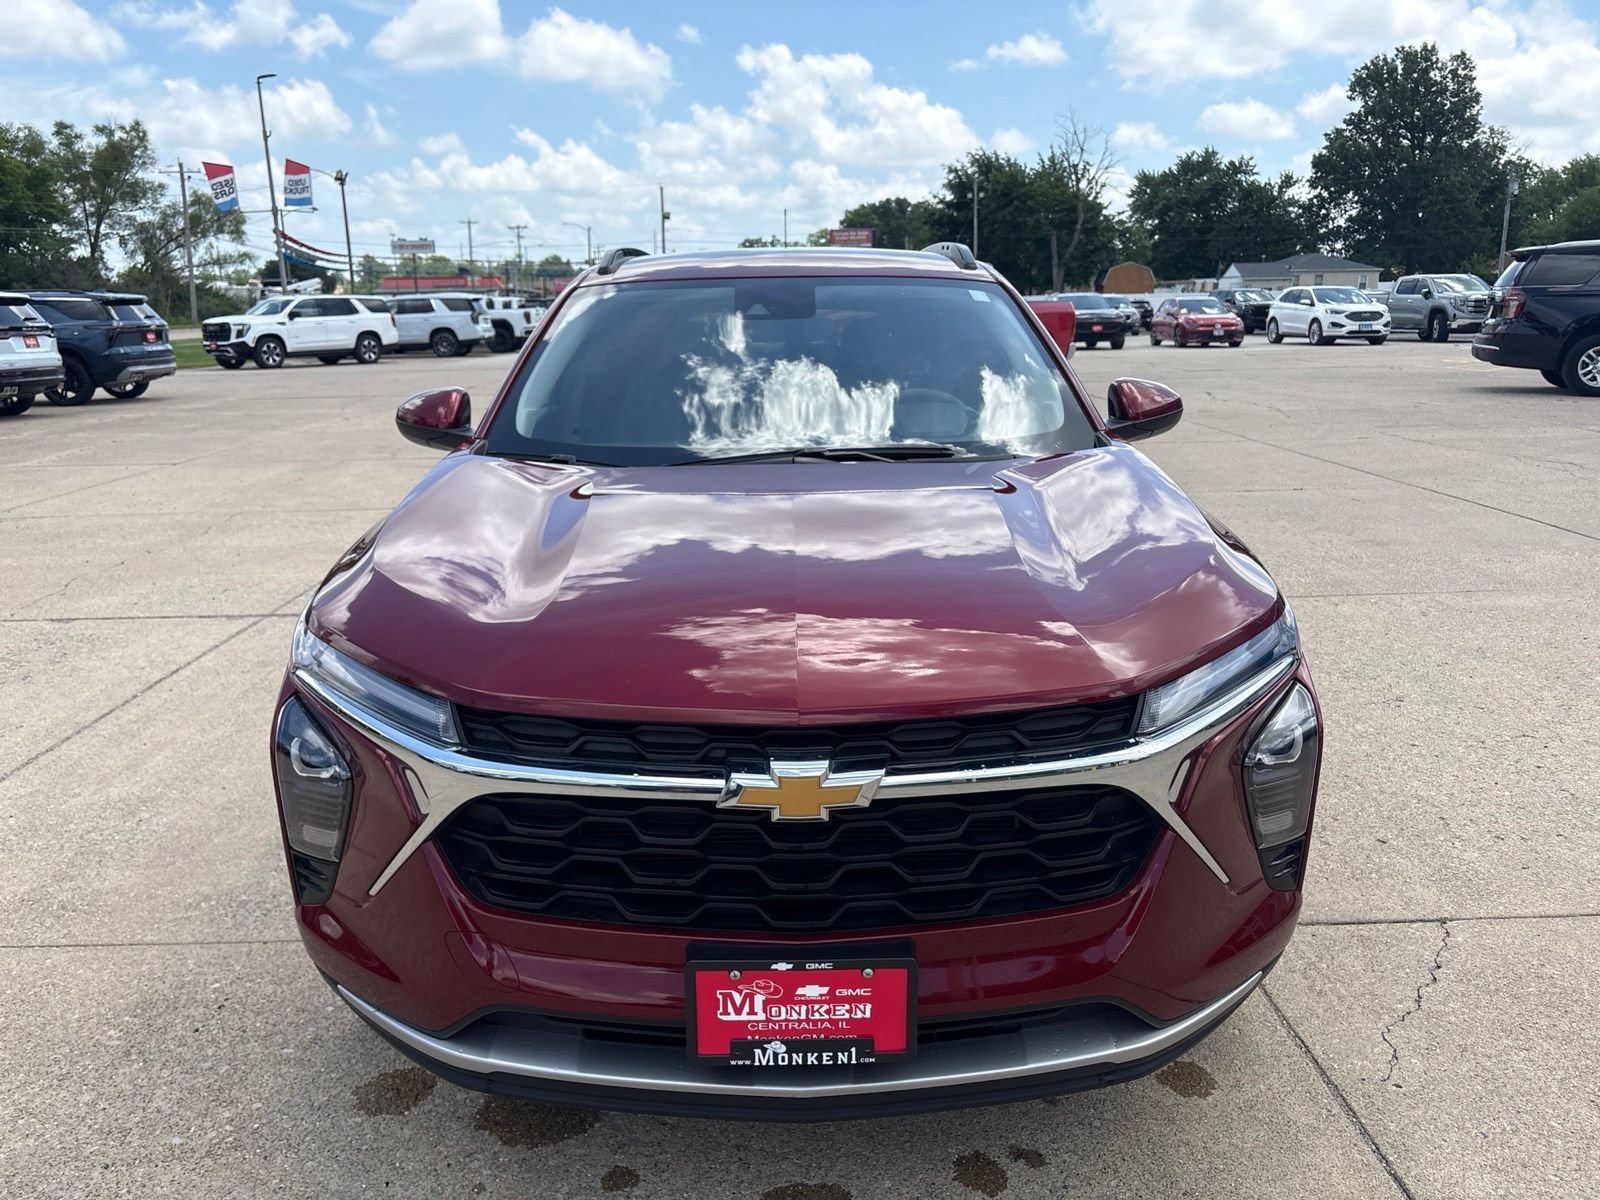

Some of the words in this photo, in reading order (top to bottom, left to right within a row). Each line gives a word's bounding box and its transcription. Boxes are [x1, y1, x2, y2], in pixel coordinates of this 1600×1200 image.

[805, 962, 833, 970] GMC
[835, 988, 872, 996] GMC
[716, 989, 873, 1021] MONKEN
[747, 1021, 835, 1031] CENTRALIA,
[838, 1021, 851, 1029] IL
